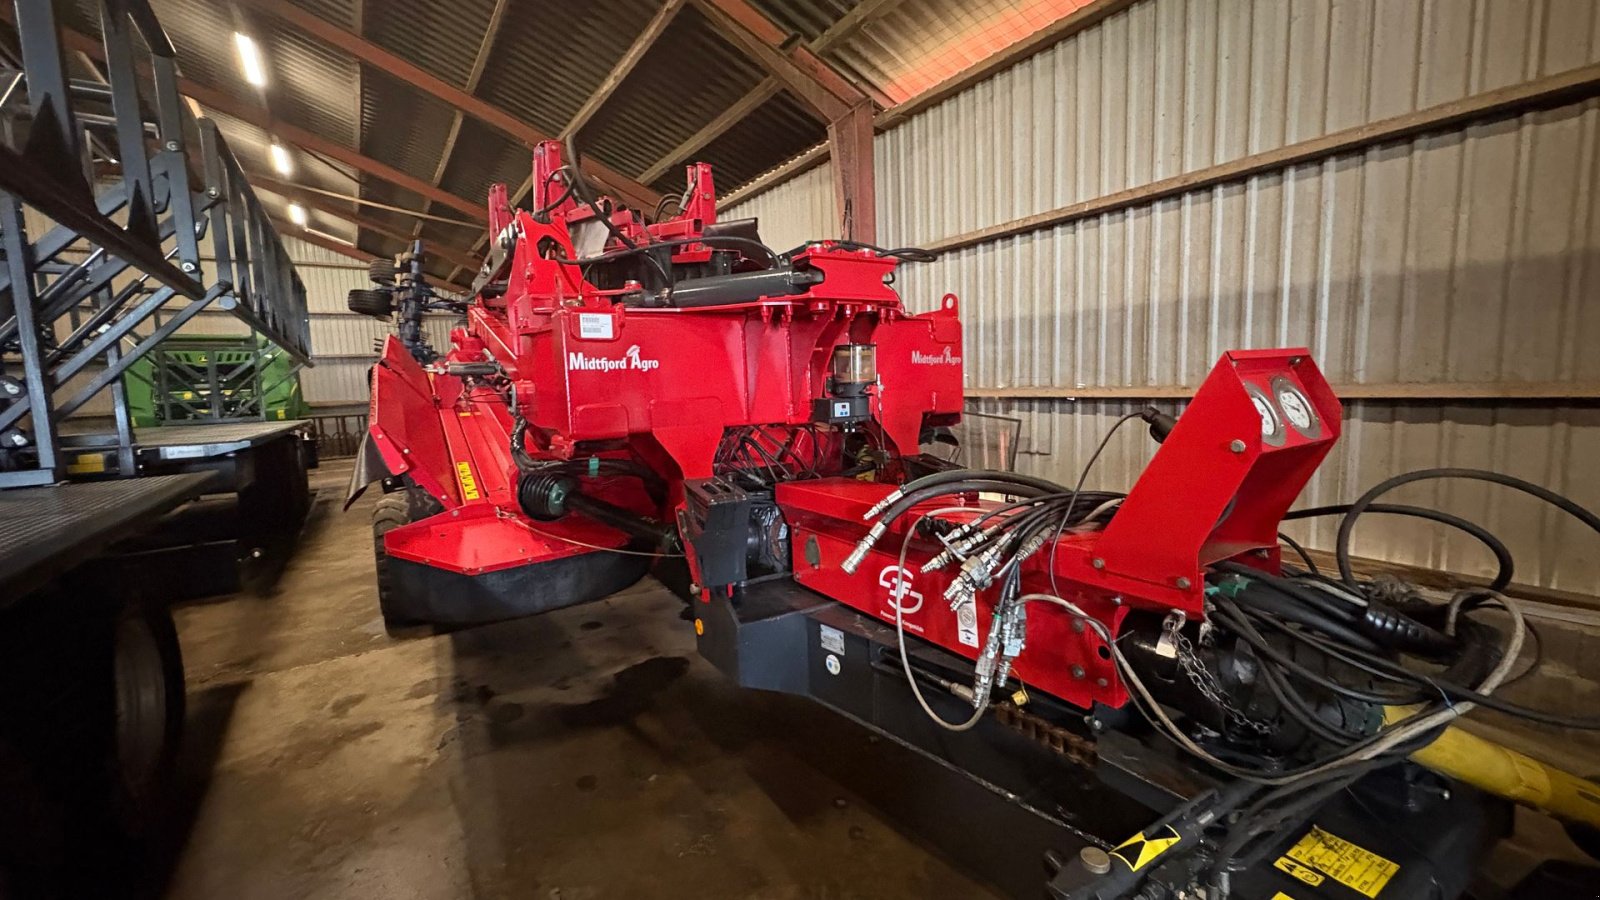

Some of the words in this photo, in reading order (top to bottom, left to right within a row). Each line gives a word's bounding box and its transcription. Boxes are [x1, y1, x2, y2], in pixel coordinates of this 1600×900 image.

[569, 352, 627, 373] Midtfjord
[630, 348, 659, 372] Agro
[911, 350, 943, 366] Midtfjord
[944, 348, 962, 366] Agro
